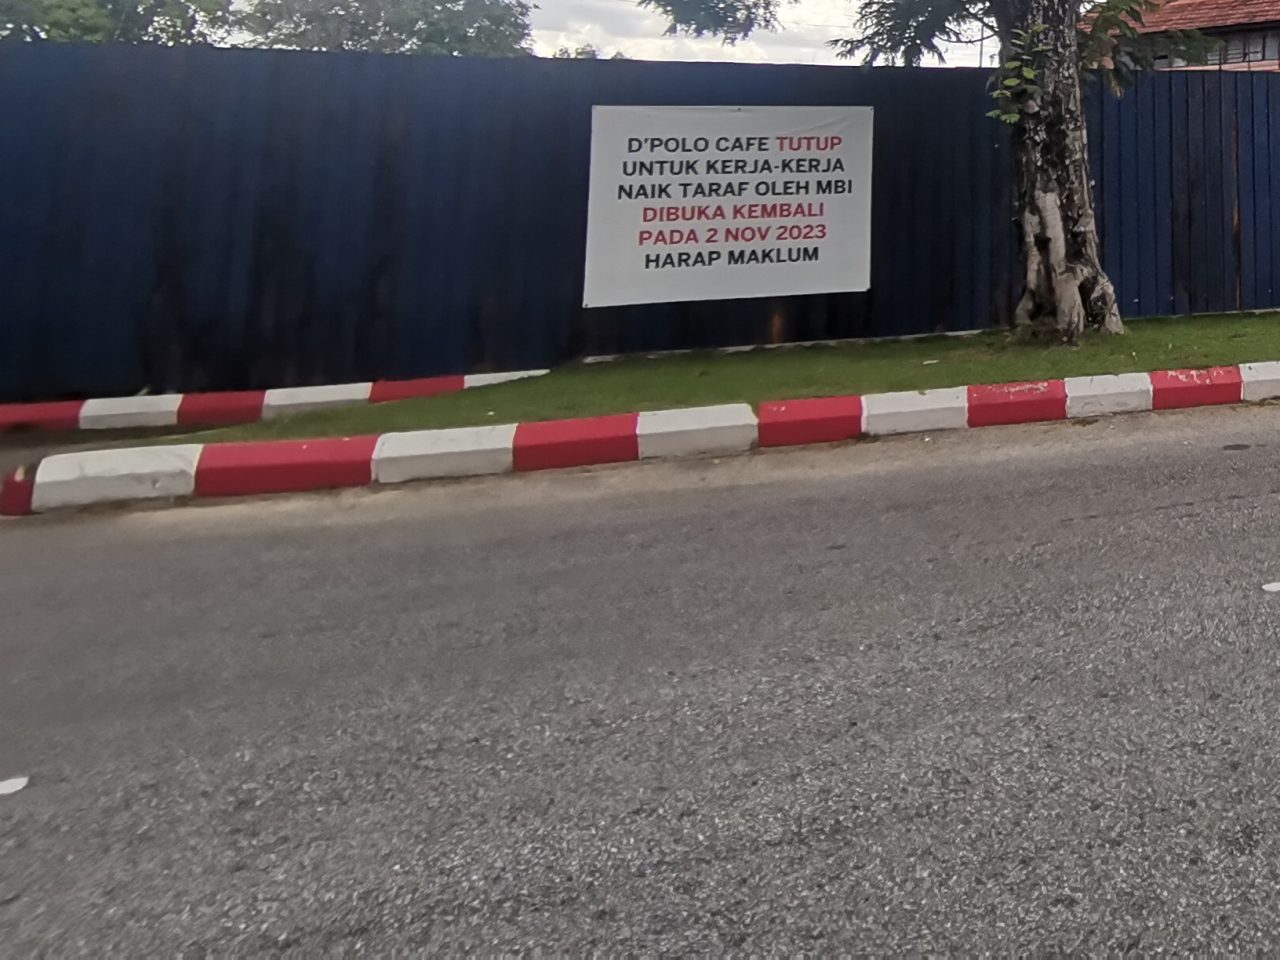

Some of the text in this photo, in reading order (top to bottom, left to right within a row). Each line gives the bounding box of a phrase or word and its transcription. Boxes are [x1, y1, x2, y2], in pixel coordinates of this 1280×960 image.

[628, 136, 842, 153] D'POLO CAFE TUTUP
[622, 158, 844, 176] UNTUK KERJA-KERJA
[618, 180, 852, 200] NAIK TARAF OLEH MBI
[643, 203, 824, 222] DIBUKA KEMBALI
[639, 224, 826, 245] PADA 2 NOV 2023
[645, 247, 819, 269] HARAP MAKLUM
